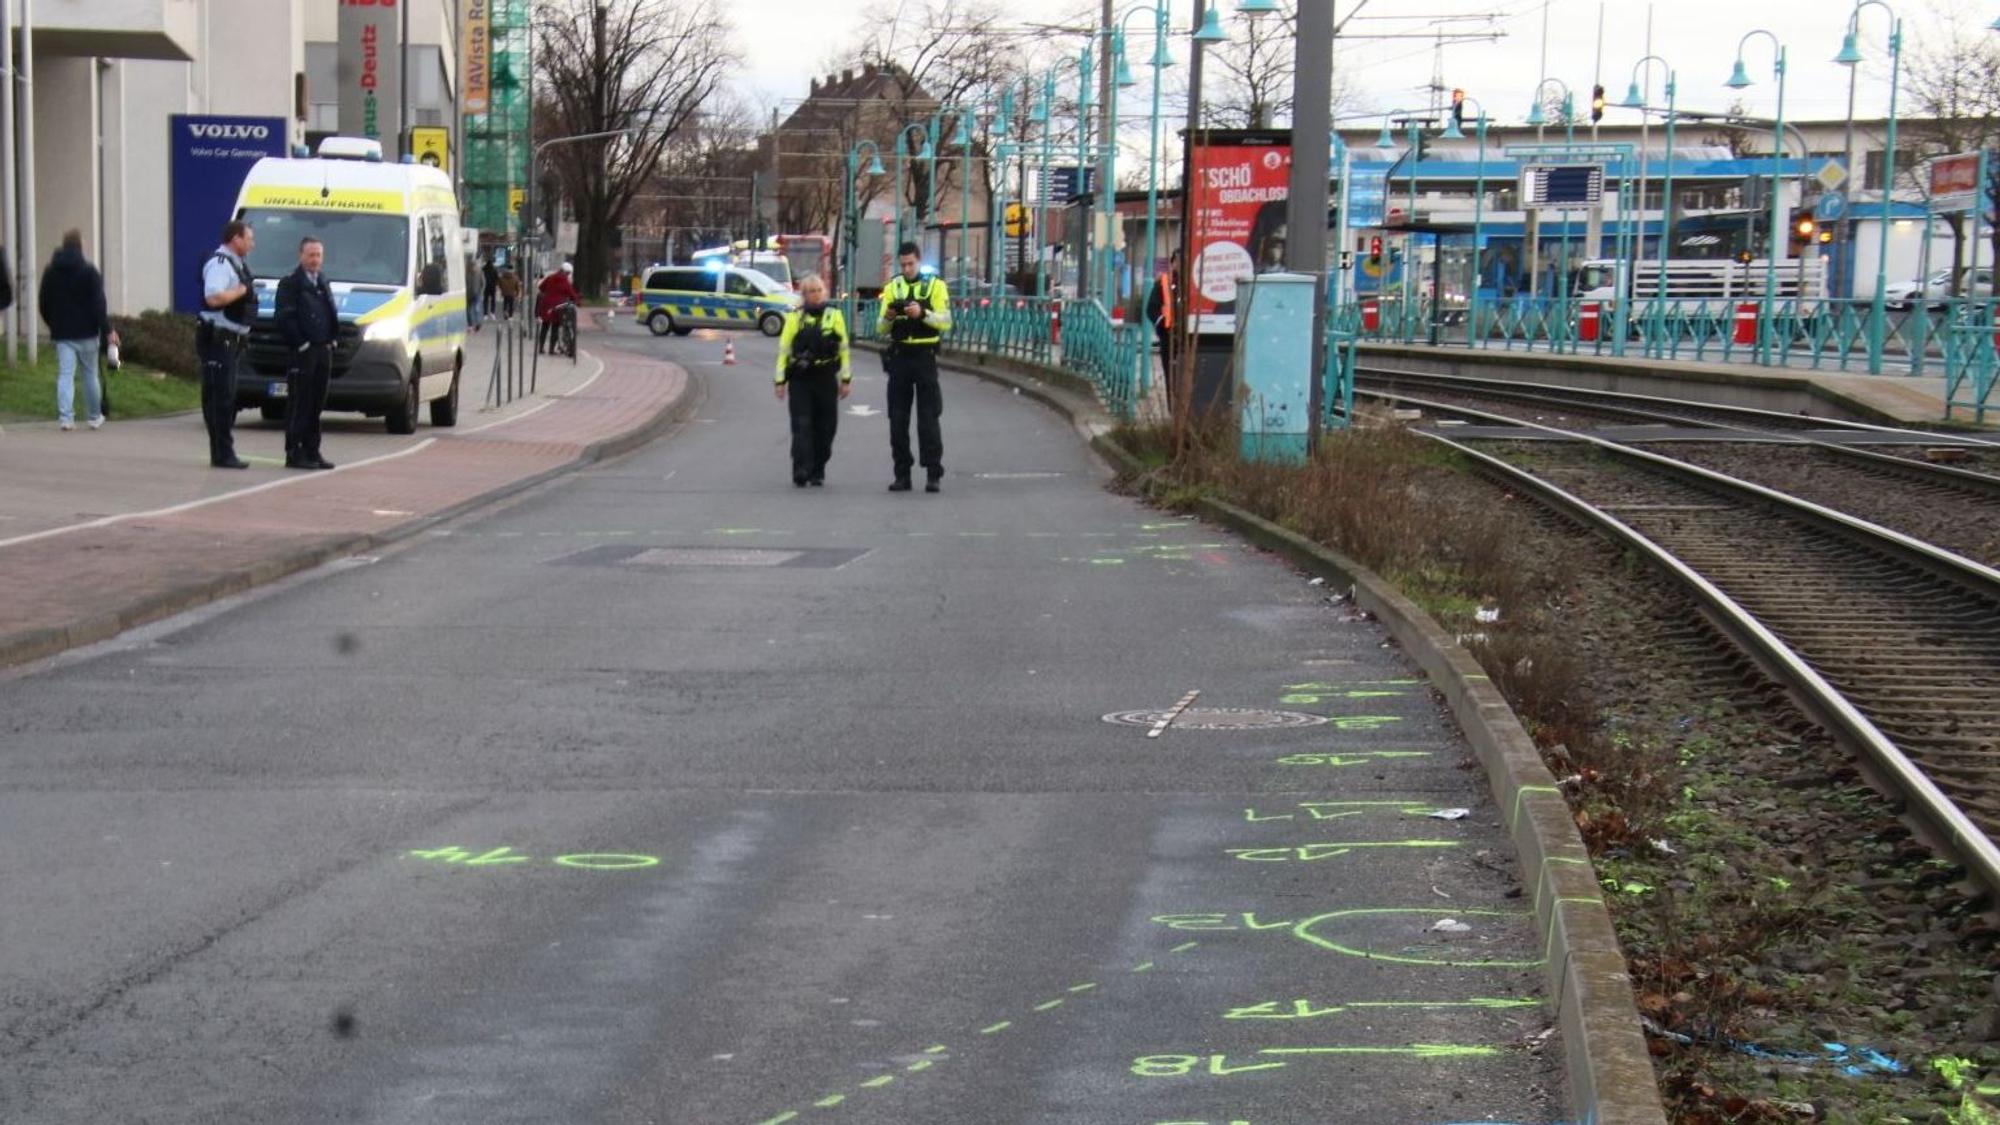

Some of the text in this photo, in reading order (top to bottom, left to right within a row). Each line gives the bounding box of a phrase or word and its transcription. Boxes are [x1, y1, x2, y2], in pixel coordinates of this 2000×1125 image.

[188, 123, 269, 139] VOLVO
[190, 147, 267, 158] Volvo Car Germany
[263, 196, 385, 210] UNFALLAUFNAHME
[1130, 1054, 1288, 1077] 18
